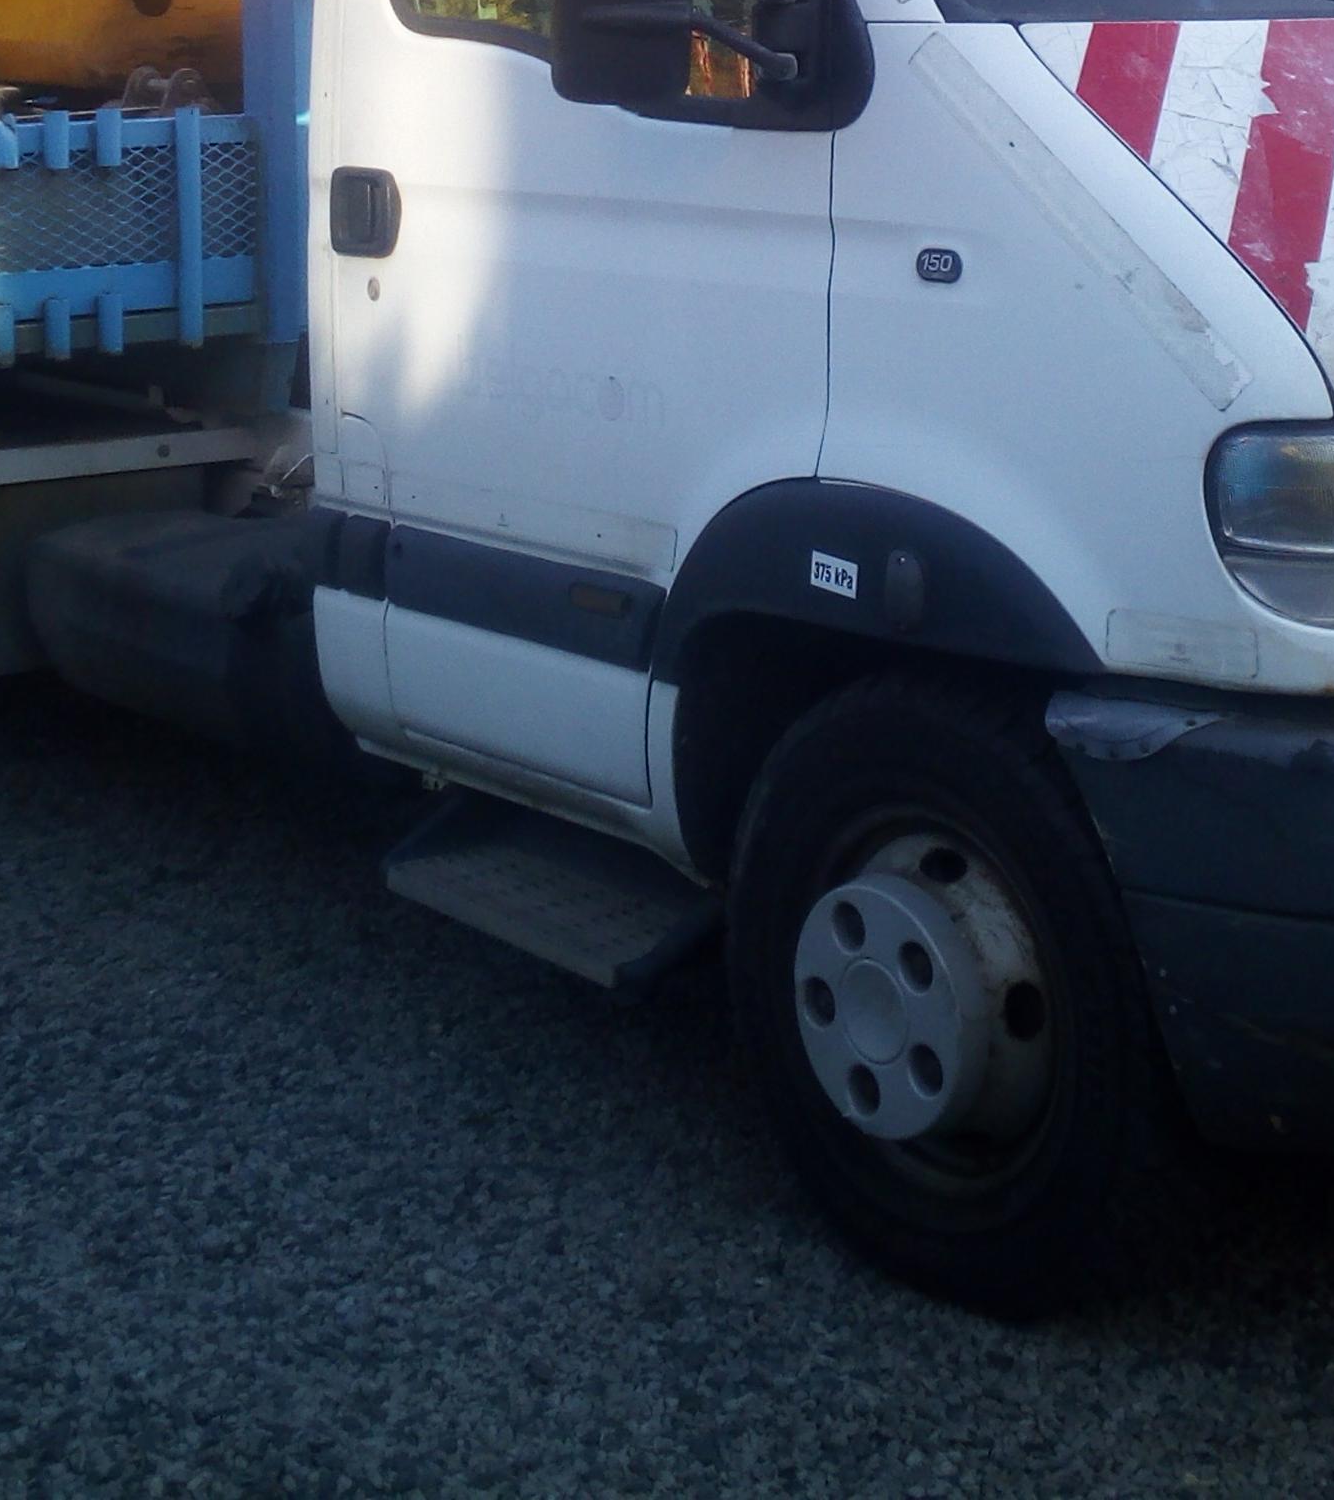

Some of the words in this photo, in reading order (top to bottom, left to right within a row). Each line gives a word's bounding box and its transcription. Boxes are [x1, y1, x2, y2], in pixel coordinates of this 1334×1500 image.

[921, 253, 953, 272] 150
[814, 561, 832, 584] 375
[834, 566, 854, 590] kPa
